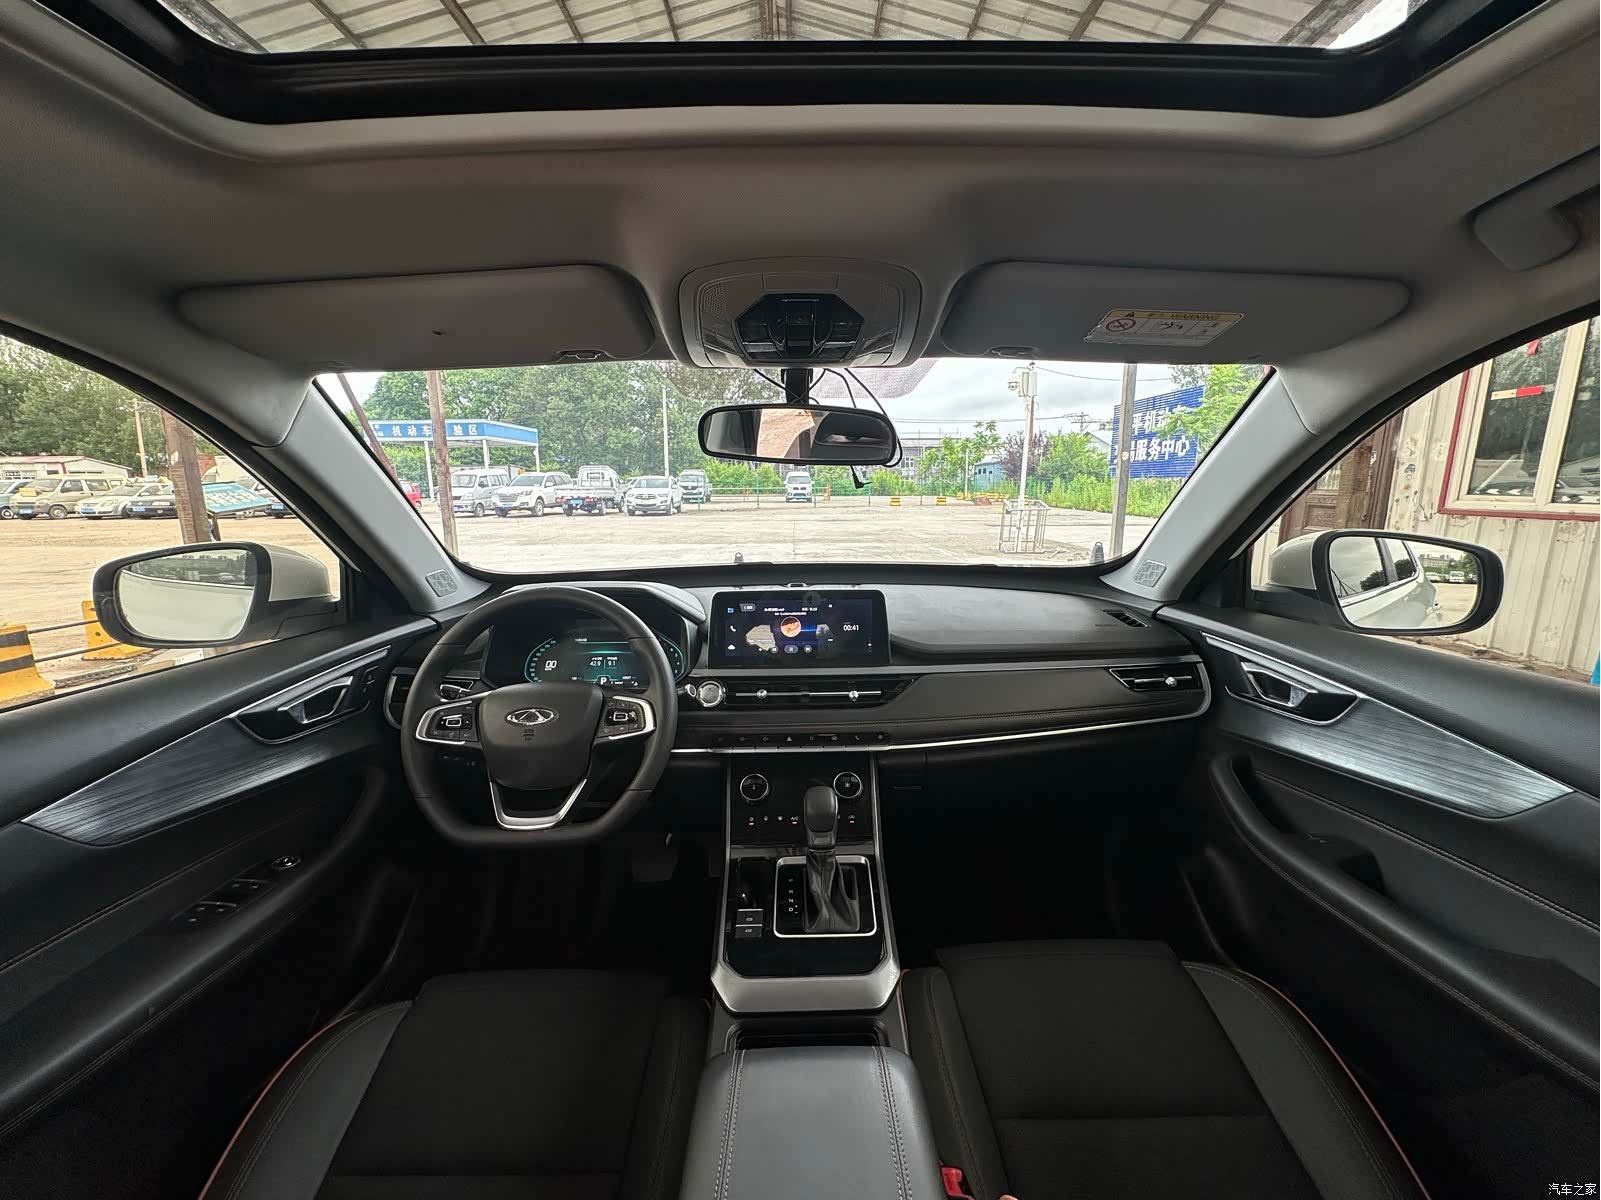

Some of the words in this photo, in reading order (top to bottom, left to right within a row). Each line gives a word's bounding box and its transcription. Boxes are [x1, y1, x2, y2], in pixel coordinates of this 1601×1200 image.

[391, 423, 478, 437] 机动车验区
[1113, 435, 1190, 463] 服务中心
[600, 677, 607, 685] P
